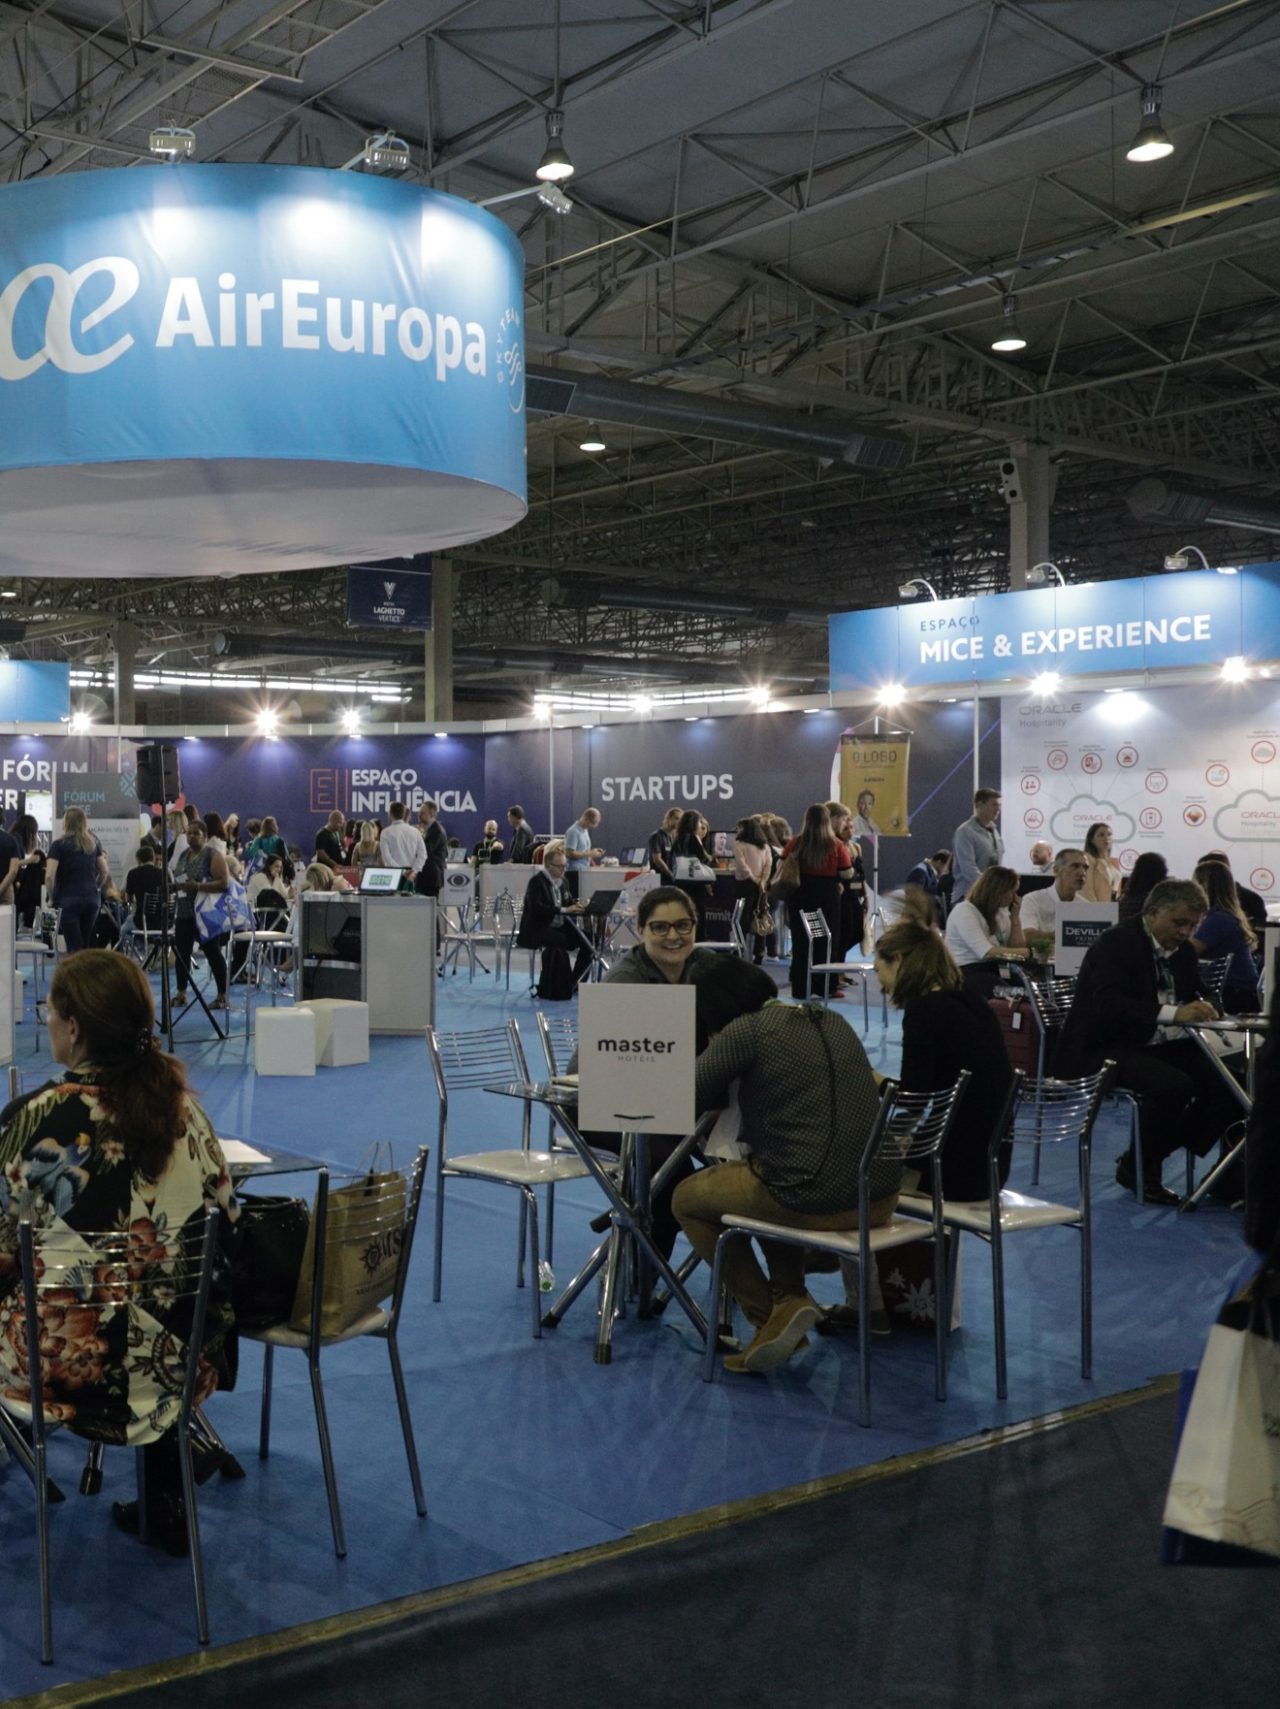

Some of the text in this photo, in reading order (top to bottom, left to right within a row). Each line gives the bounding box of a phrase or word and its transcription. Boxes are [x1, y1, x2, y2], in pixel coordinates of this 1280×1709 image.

[373, 606, 406, 616] LAGHETTO
[920, 616, 980, 632] ESPAÇO
[920, 614, 1212, 664] MICE & EXPERIENCE
[1019, 703, 1082, 716] ORACLE
[1019, 718, 1067, 728] Hospitality
[351, 769, 418, 790] ESPAÇO
[601, 773, 734, 801] STARTUPS
[705, 910, 732, 921] mmit
[597, 1037, 676, 1053] master
